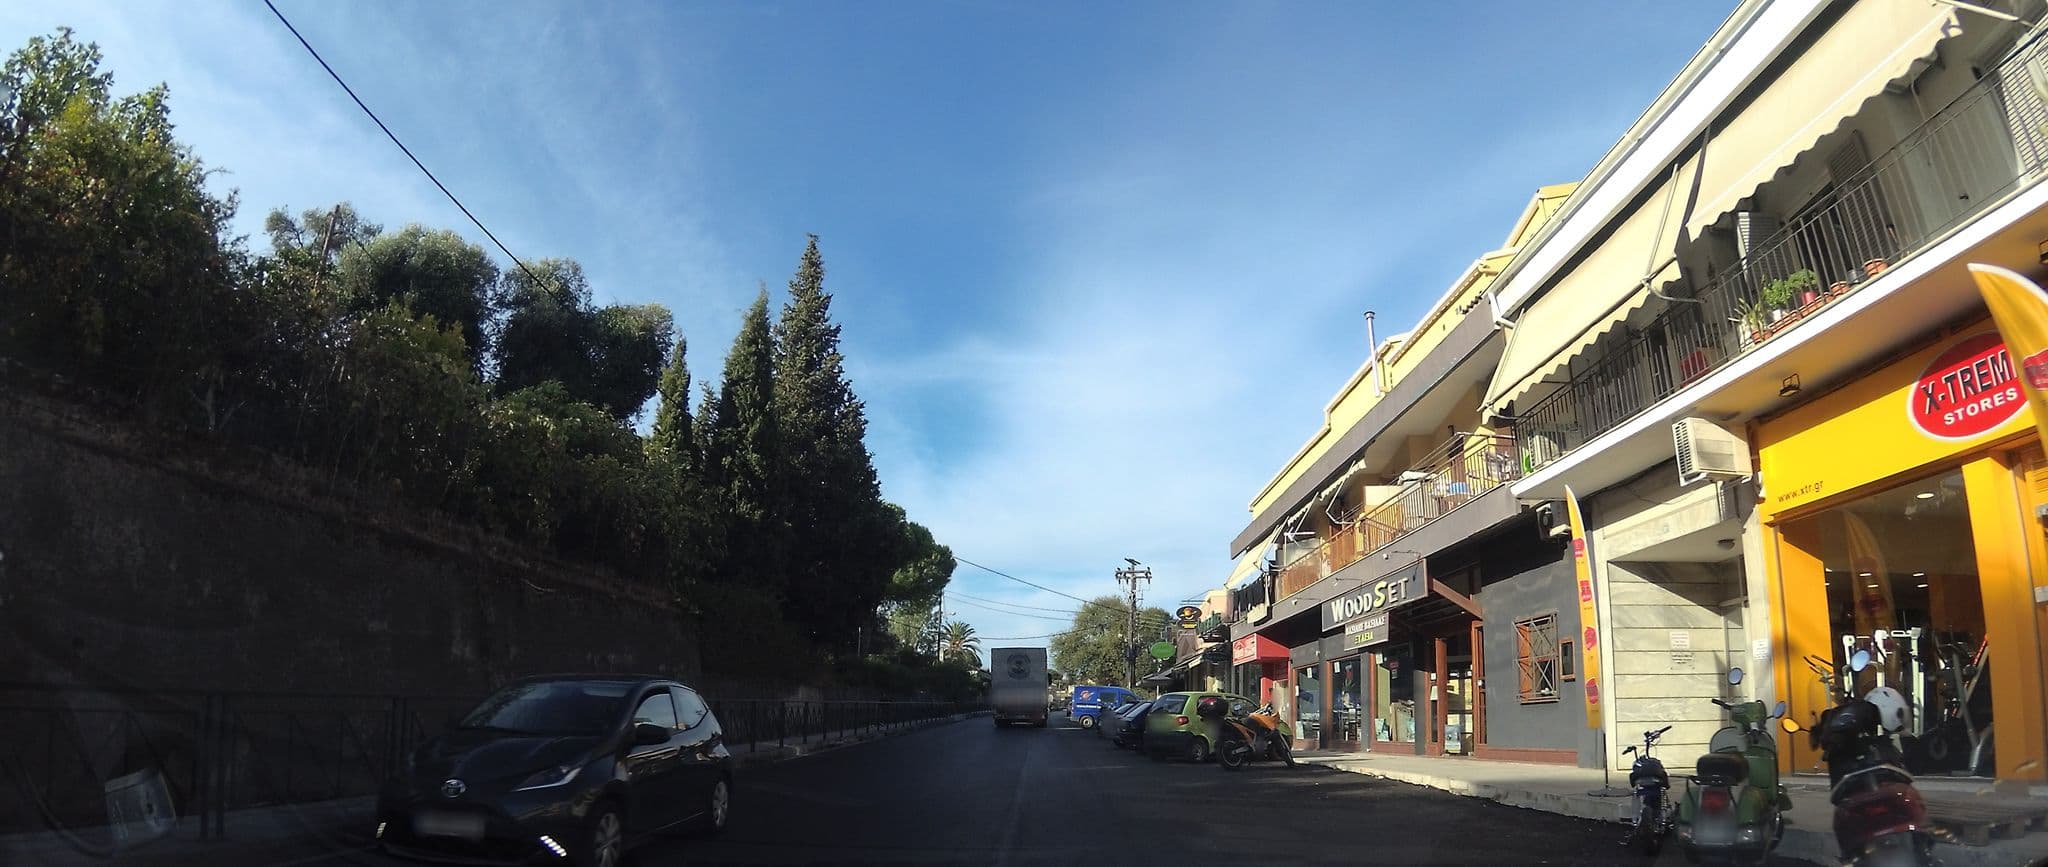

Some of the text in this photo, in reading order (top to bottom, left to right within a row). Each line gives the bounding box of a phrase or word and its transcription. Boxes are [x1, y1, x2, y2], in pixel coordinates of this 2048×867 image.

[1921, 349, 2017, 414] X-TREM
[1944, 388, 2018, 424] STORES
[1778, 480, 1823, 502] www.xtr.gr
